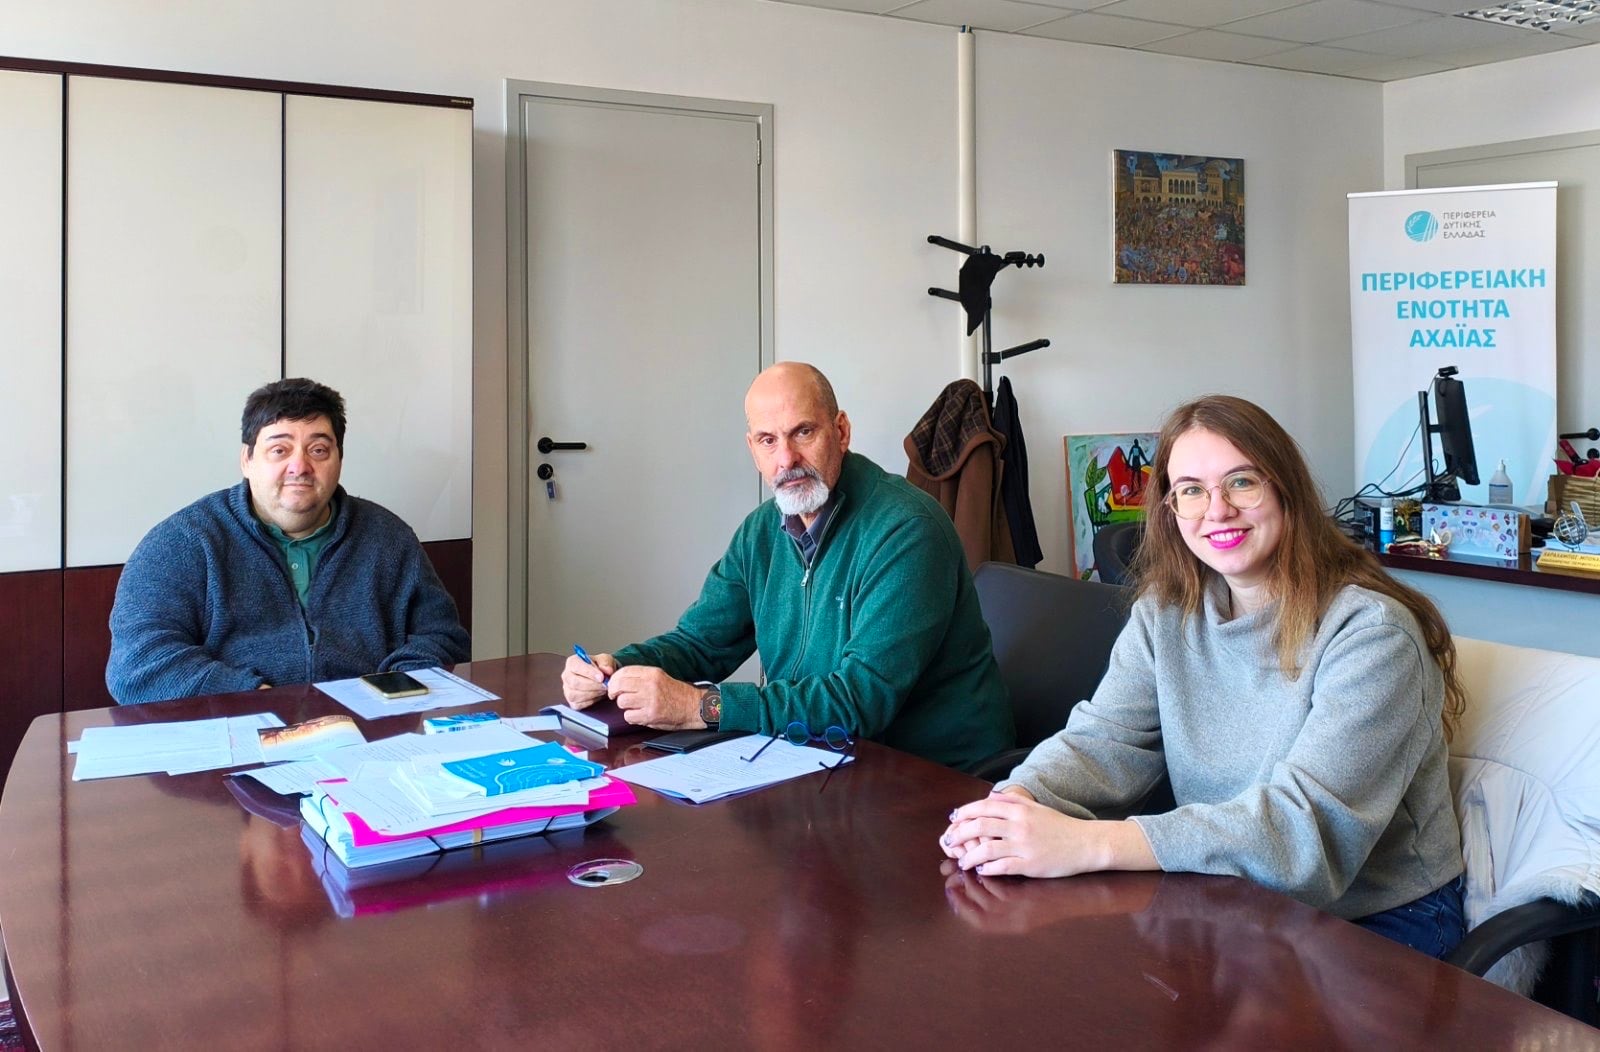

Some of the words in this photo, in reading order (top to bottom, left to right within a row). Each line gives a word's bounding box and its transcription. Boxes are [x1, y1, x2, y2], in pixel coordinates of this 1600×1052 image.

[1443, 210, 1496, 220] ΠΕΡΙΦΕΡΕΙΑ
[1443, 220, 1482, 230] ΔΥΤΙΚΗΣ
[1443, 230, 1486, 239] ΕΛΛΑΔΑΣ
[1362, 269, 1545, 291] ΠΕΡΙΦΕΡΕΙΑΚΗ
[1396, 299, 1510, 319] ΕΝΟΤΗΤΑ
[1409, 323, 1496, 348] ΑΧΑΪΑΣ
